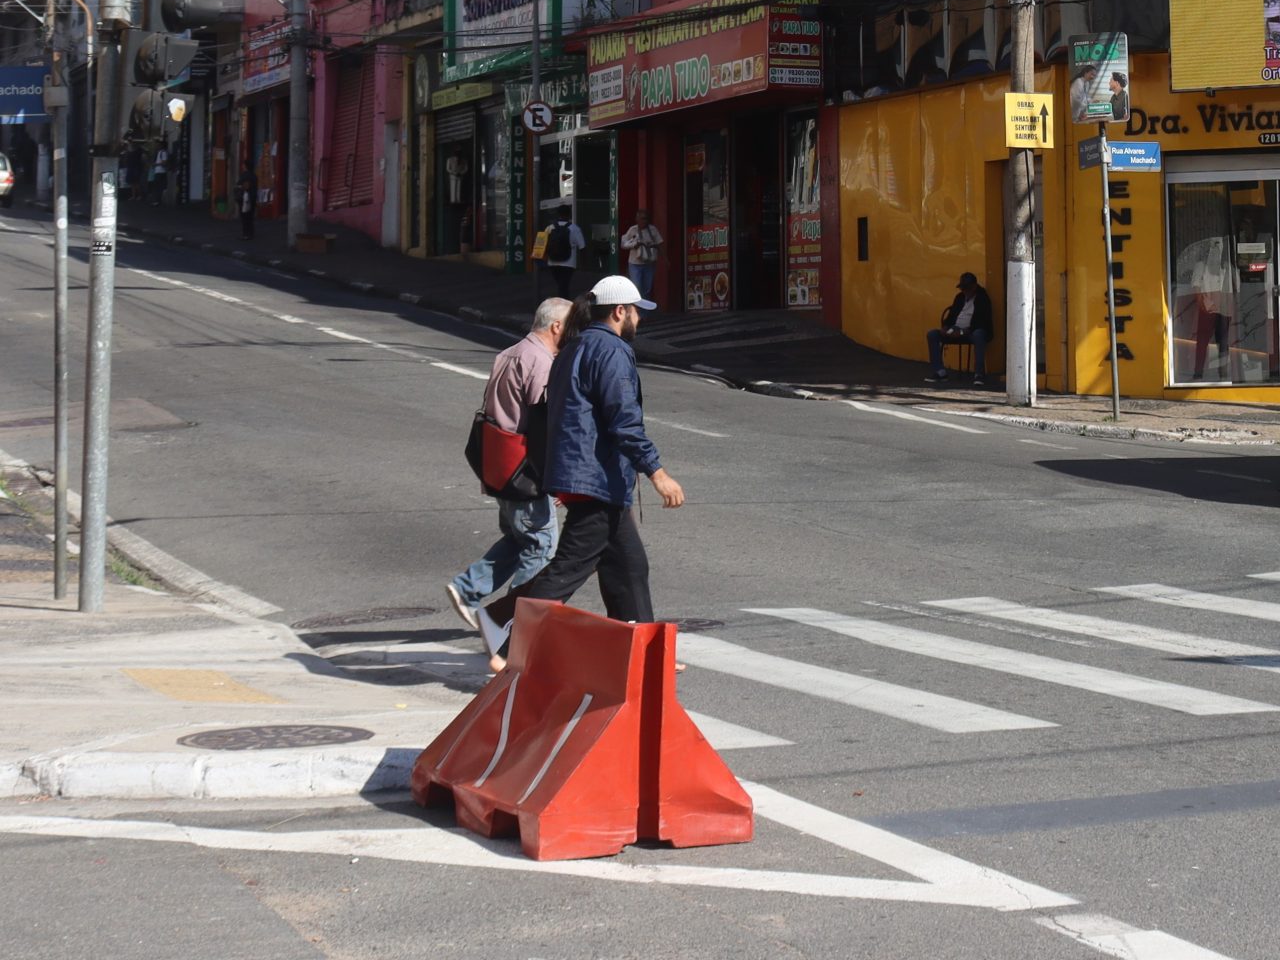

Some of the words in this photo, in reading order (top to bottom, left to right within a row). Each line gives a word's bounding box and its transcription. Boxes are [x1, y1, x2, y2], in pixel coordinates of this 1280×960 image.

[782, 20, 800, 35] PAPA
[801, 21, 820, 36] TUDO
[0, 85, 42, 96] achado
[640, 64, 673, 111] PAPA
[674, 54, 710, 103] TUDO
[1124, 108, 1189, 136] Dra.
[513, 126, 524, 262] DENTISTAS
[1101, 181, 1134, 360] ENTISTA
